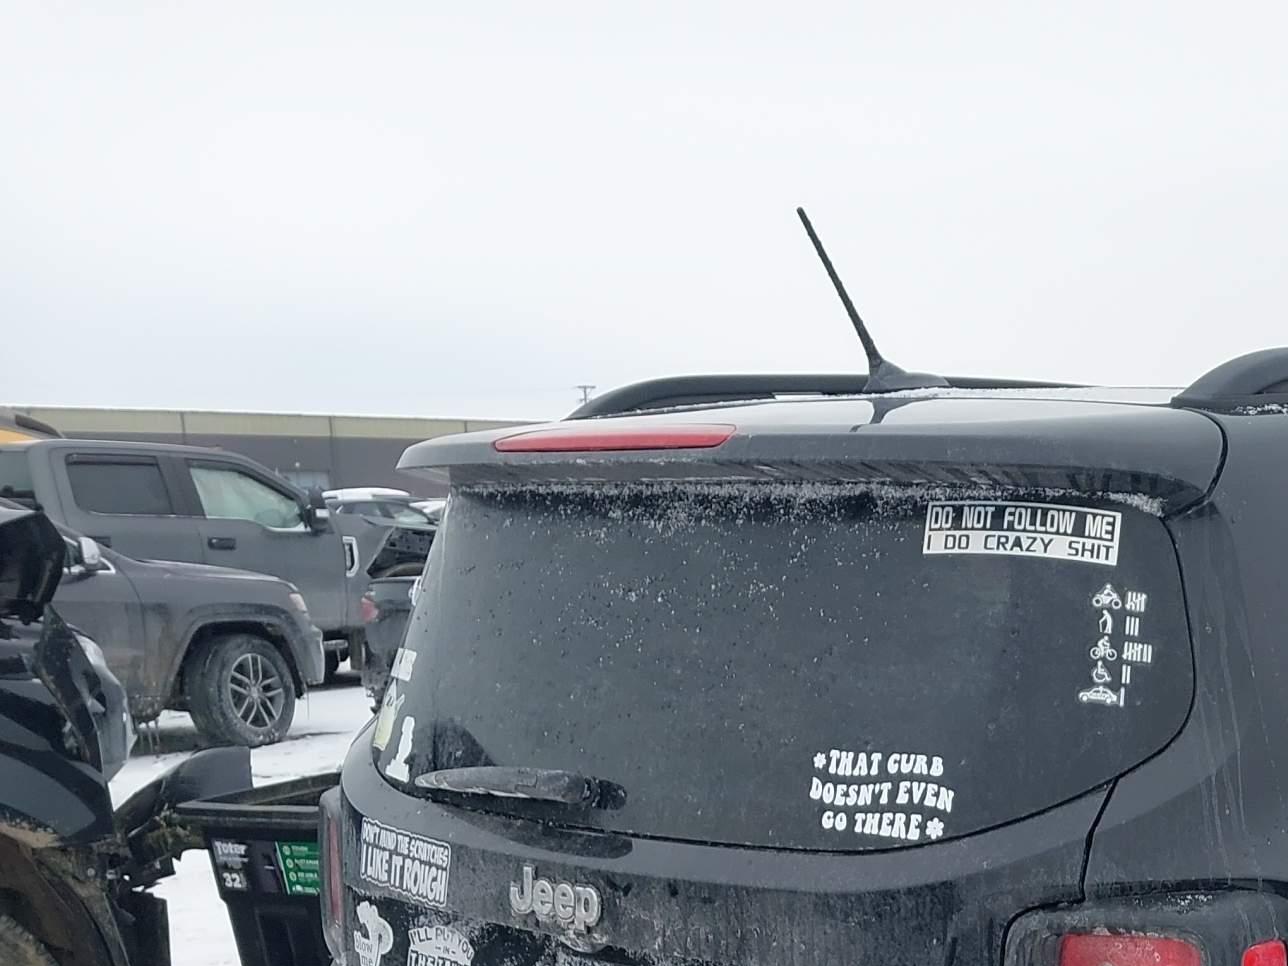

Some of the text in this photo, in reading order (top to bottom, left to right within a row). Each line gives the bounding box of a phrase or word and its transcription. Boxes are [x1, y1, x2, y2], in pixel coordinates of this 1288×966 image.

[931, 506, 1115, 540] DO NOT FOLLOW ME
[926, 534, 1115, 561] I DO CRAZY SHIT
[828, 749, 944, 777] THAT CURB
[809, 776, 955, 813] DOESN'T EVEN
[821, 811, 922, 840] GO THERE
[222, 872, 242, 888] 32
[361, 844, 447, 903] I LIKE IT ROUGH
[510, 865, 601, 931] Jeep
[409, 927, 433, 945] I'LL
